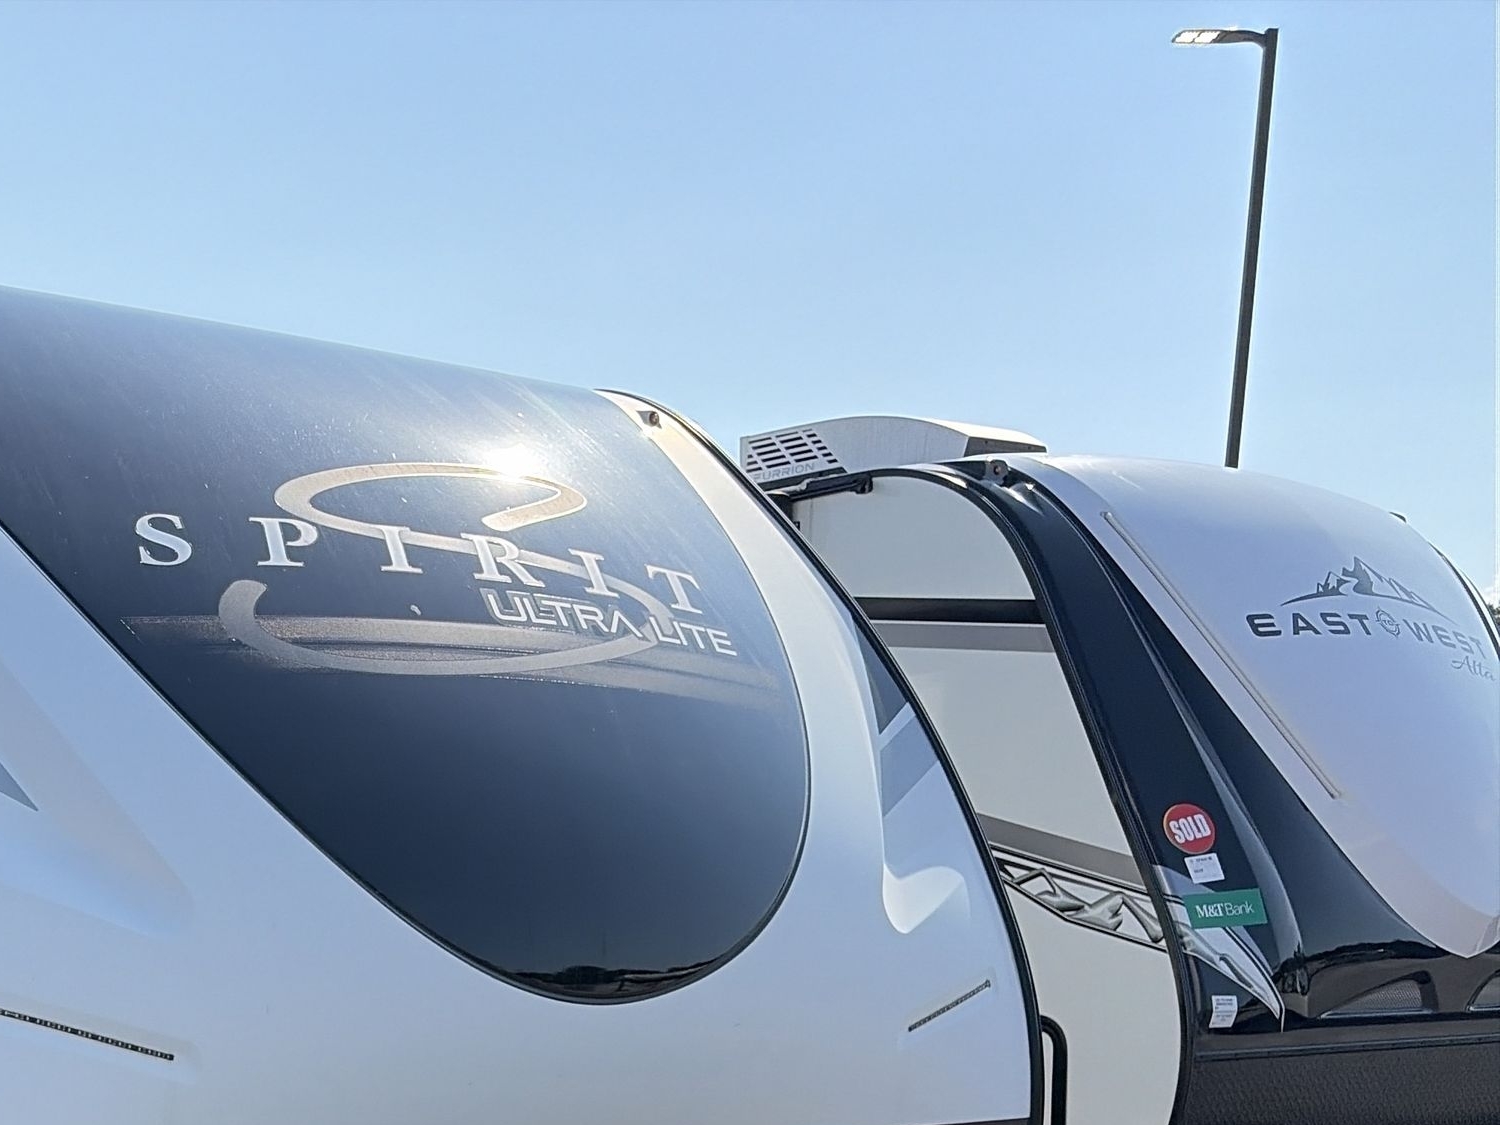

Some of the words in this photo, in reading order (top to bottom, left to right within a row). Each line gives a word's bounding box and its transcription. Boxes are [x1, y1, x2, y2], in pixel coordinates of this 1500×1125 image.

[135, 512, 704, 615] SPIRIT
[484, 591, 644, 638] ULTRA
[648, 615, 738, 657] LITE
[1246, 611, 1371, 637] EAST
[1402, 618, 1487, 660] WEST
[1450, 655, 1497, 682] Alta
[1168, 813, 1212, 844] SOLD
